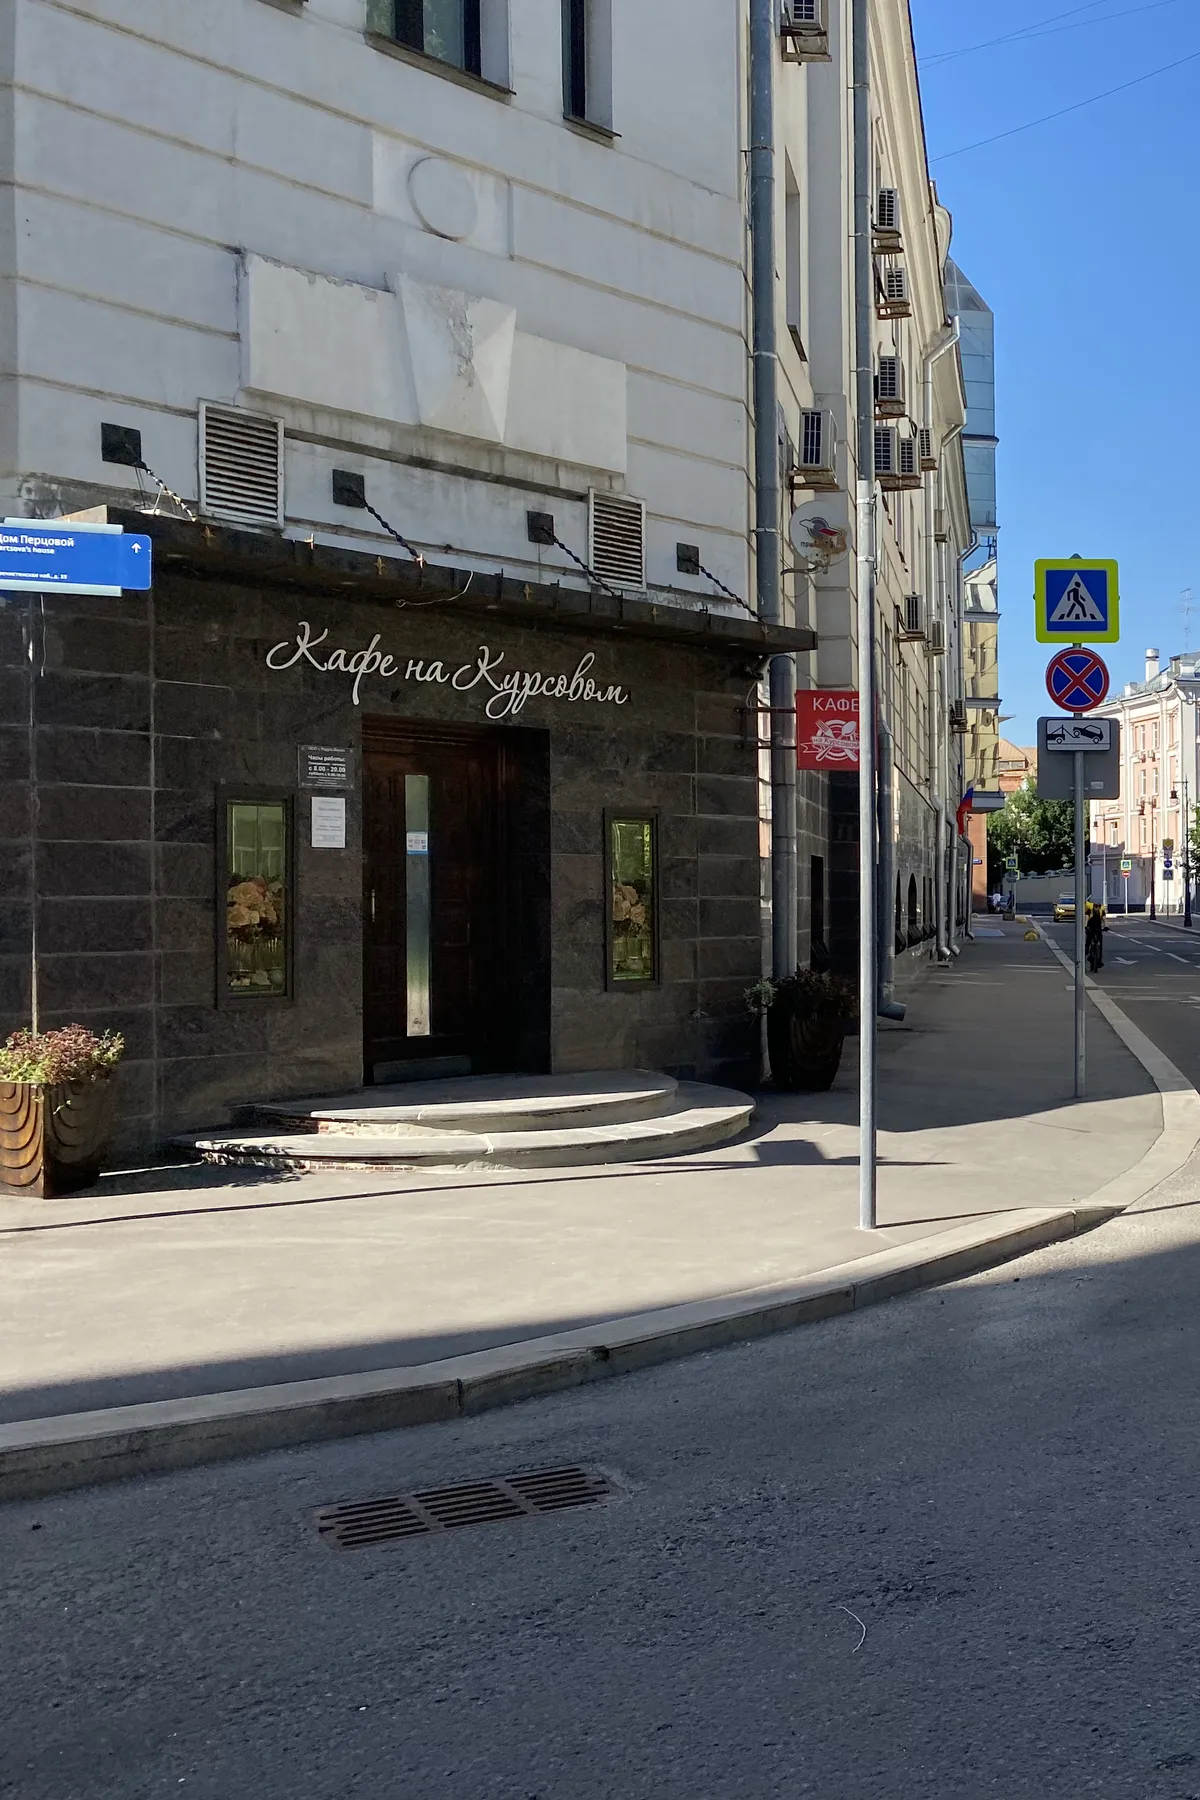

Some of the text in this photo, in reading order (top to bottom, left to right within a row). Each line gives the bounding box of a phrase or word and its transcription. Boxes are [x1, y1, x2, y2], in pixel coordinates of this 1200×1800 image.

[20, 534, 75, 548] Перцовой
[32, 547, 55, 555] house
[265, 621, 629, 719] Кафе на Курсовом
[812, 697, 859, 712] КАФЕ
